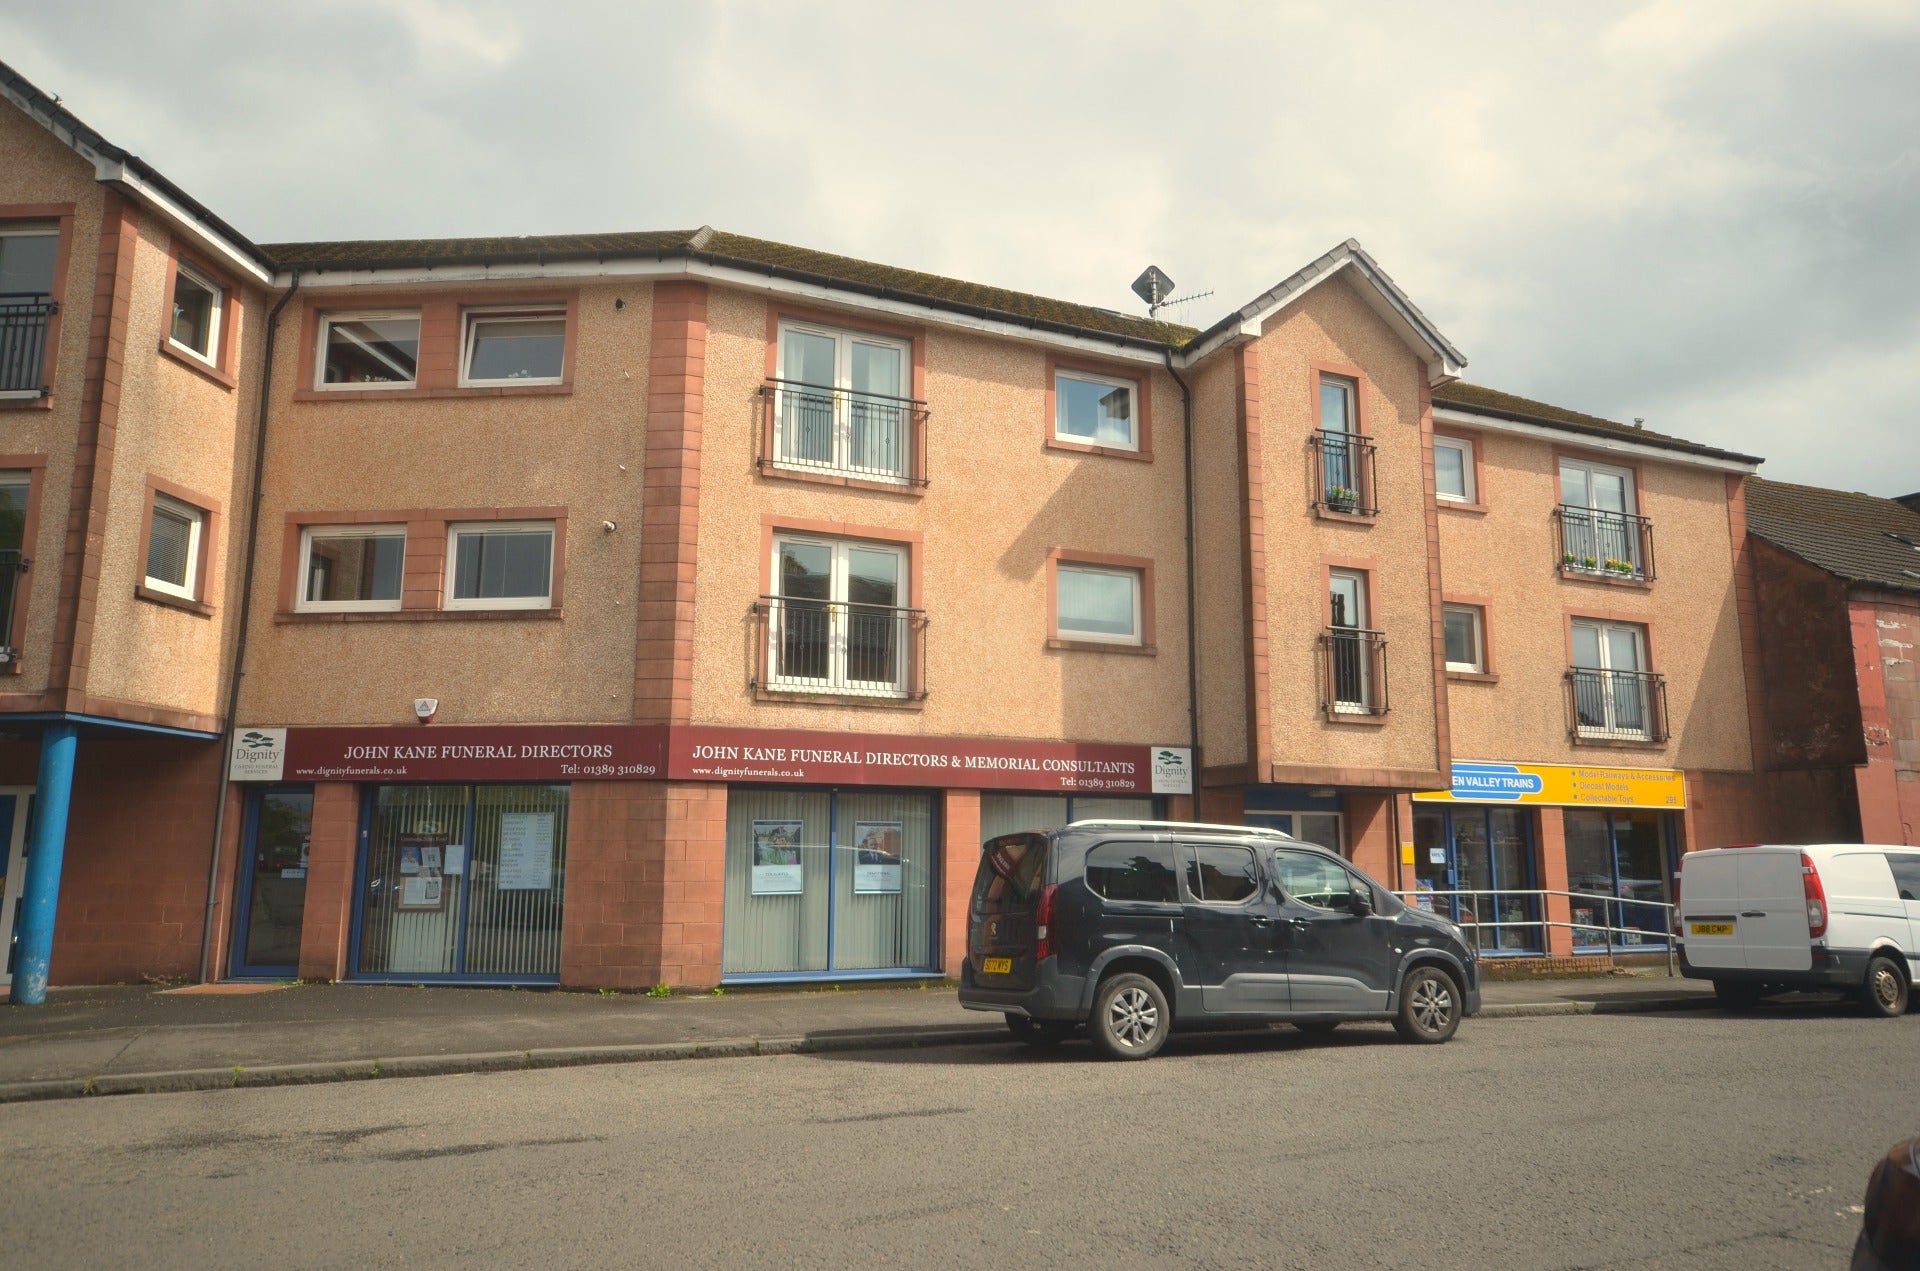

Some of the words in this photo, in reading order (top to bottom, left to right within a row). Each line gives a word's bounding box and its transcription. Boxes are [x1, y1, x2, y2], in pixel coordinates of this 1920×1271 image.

[236, 748, 279, 763] Dignity
[344, 746, 389, 760] JOHN
[393, 746, 437, 759] KANE
[441, 745, 516, 759] FUNERAL
[521, 744, 613, 758] DIRECTORS
[692, 745, 739, 760] JOHN
[743, 747, 786, 761] KANE
[790, 749, 862, 764] FUNERAL
[866, 752, 948, 767] DIRECTORS
[951, 756, 961, 768] &
[964, 756, 1040, 771] MEMORIAL
[1043, 760, 1135, 774] CONSULTANTS
[296, 766, 408, 777] www.dignityfunerals.co.uk
[561, 764, 580, 774] Tel:
[583, 764, 615, 776] 01389
[617, 764, 656, 776] 310829
[692, 766, 805, 778] www.dignityfunerals.co.uk
[1155, 765, 1187, 778] Dignity
[1579, 770, 1599, 778] Model
[1600, 771, 1629, 780] Railways
[1637, 773, 1676, 781] Accessories
[1060, 776, 1076, 786] Tel:
[1078, 778, 1104, 789] 01389
[1105, 779, 1135, 789] 310829
[1465, 776, 1500, 787] VALLEY
[1501, 778, 1534, 789] TRAINS
[1580, 782, 1604, 790] Diecast
[1605, 783, 1629, 791] Models
[1581, 793, 1617, 802] Collectable
[1619, 795, 1635, 804] Toys
